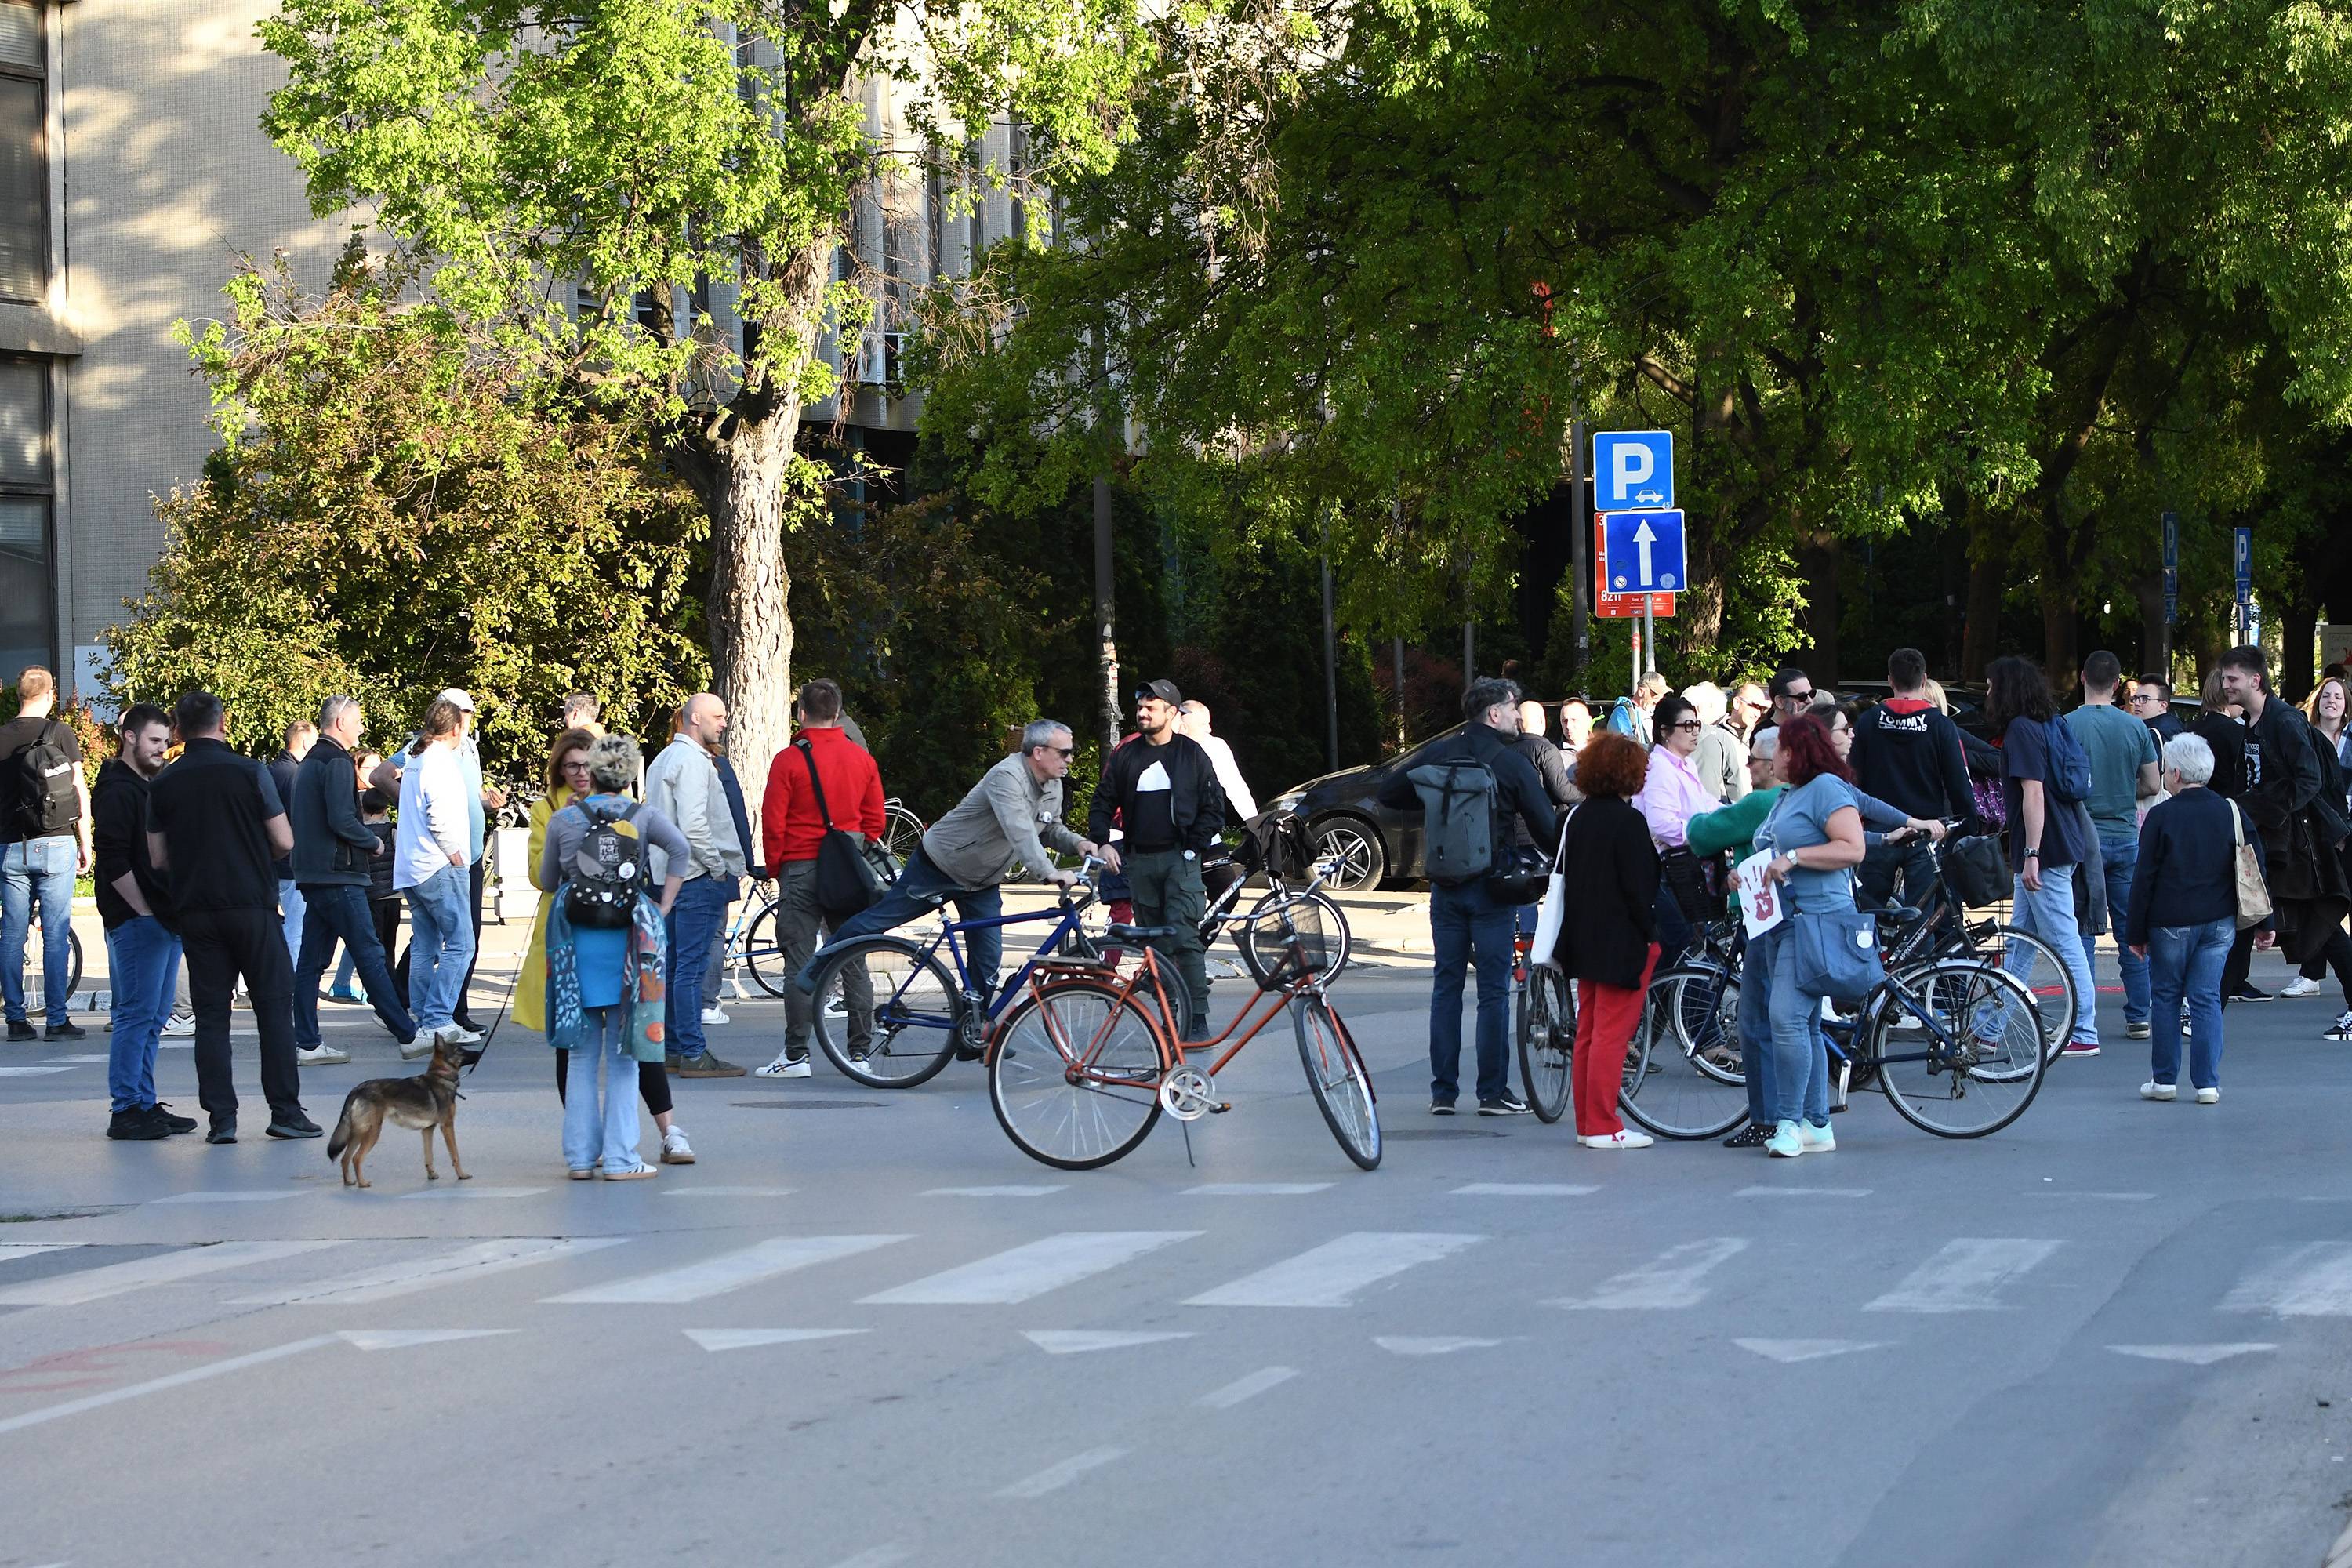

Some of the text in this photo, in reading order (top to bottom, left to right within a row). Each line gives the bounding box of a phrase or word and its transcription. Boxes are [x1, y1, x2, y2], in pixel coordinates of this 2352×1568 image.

[1613, 443, 1653, 500] P
[2166, 521, 2174, 560] P
[2238, 535, 2247, 572] P
[1879, 710, 1926, 727] TOMMY
